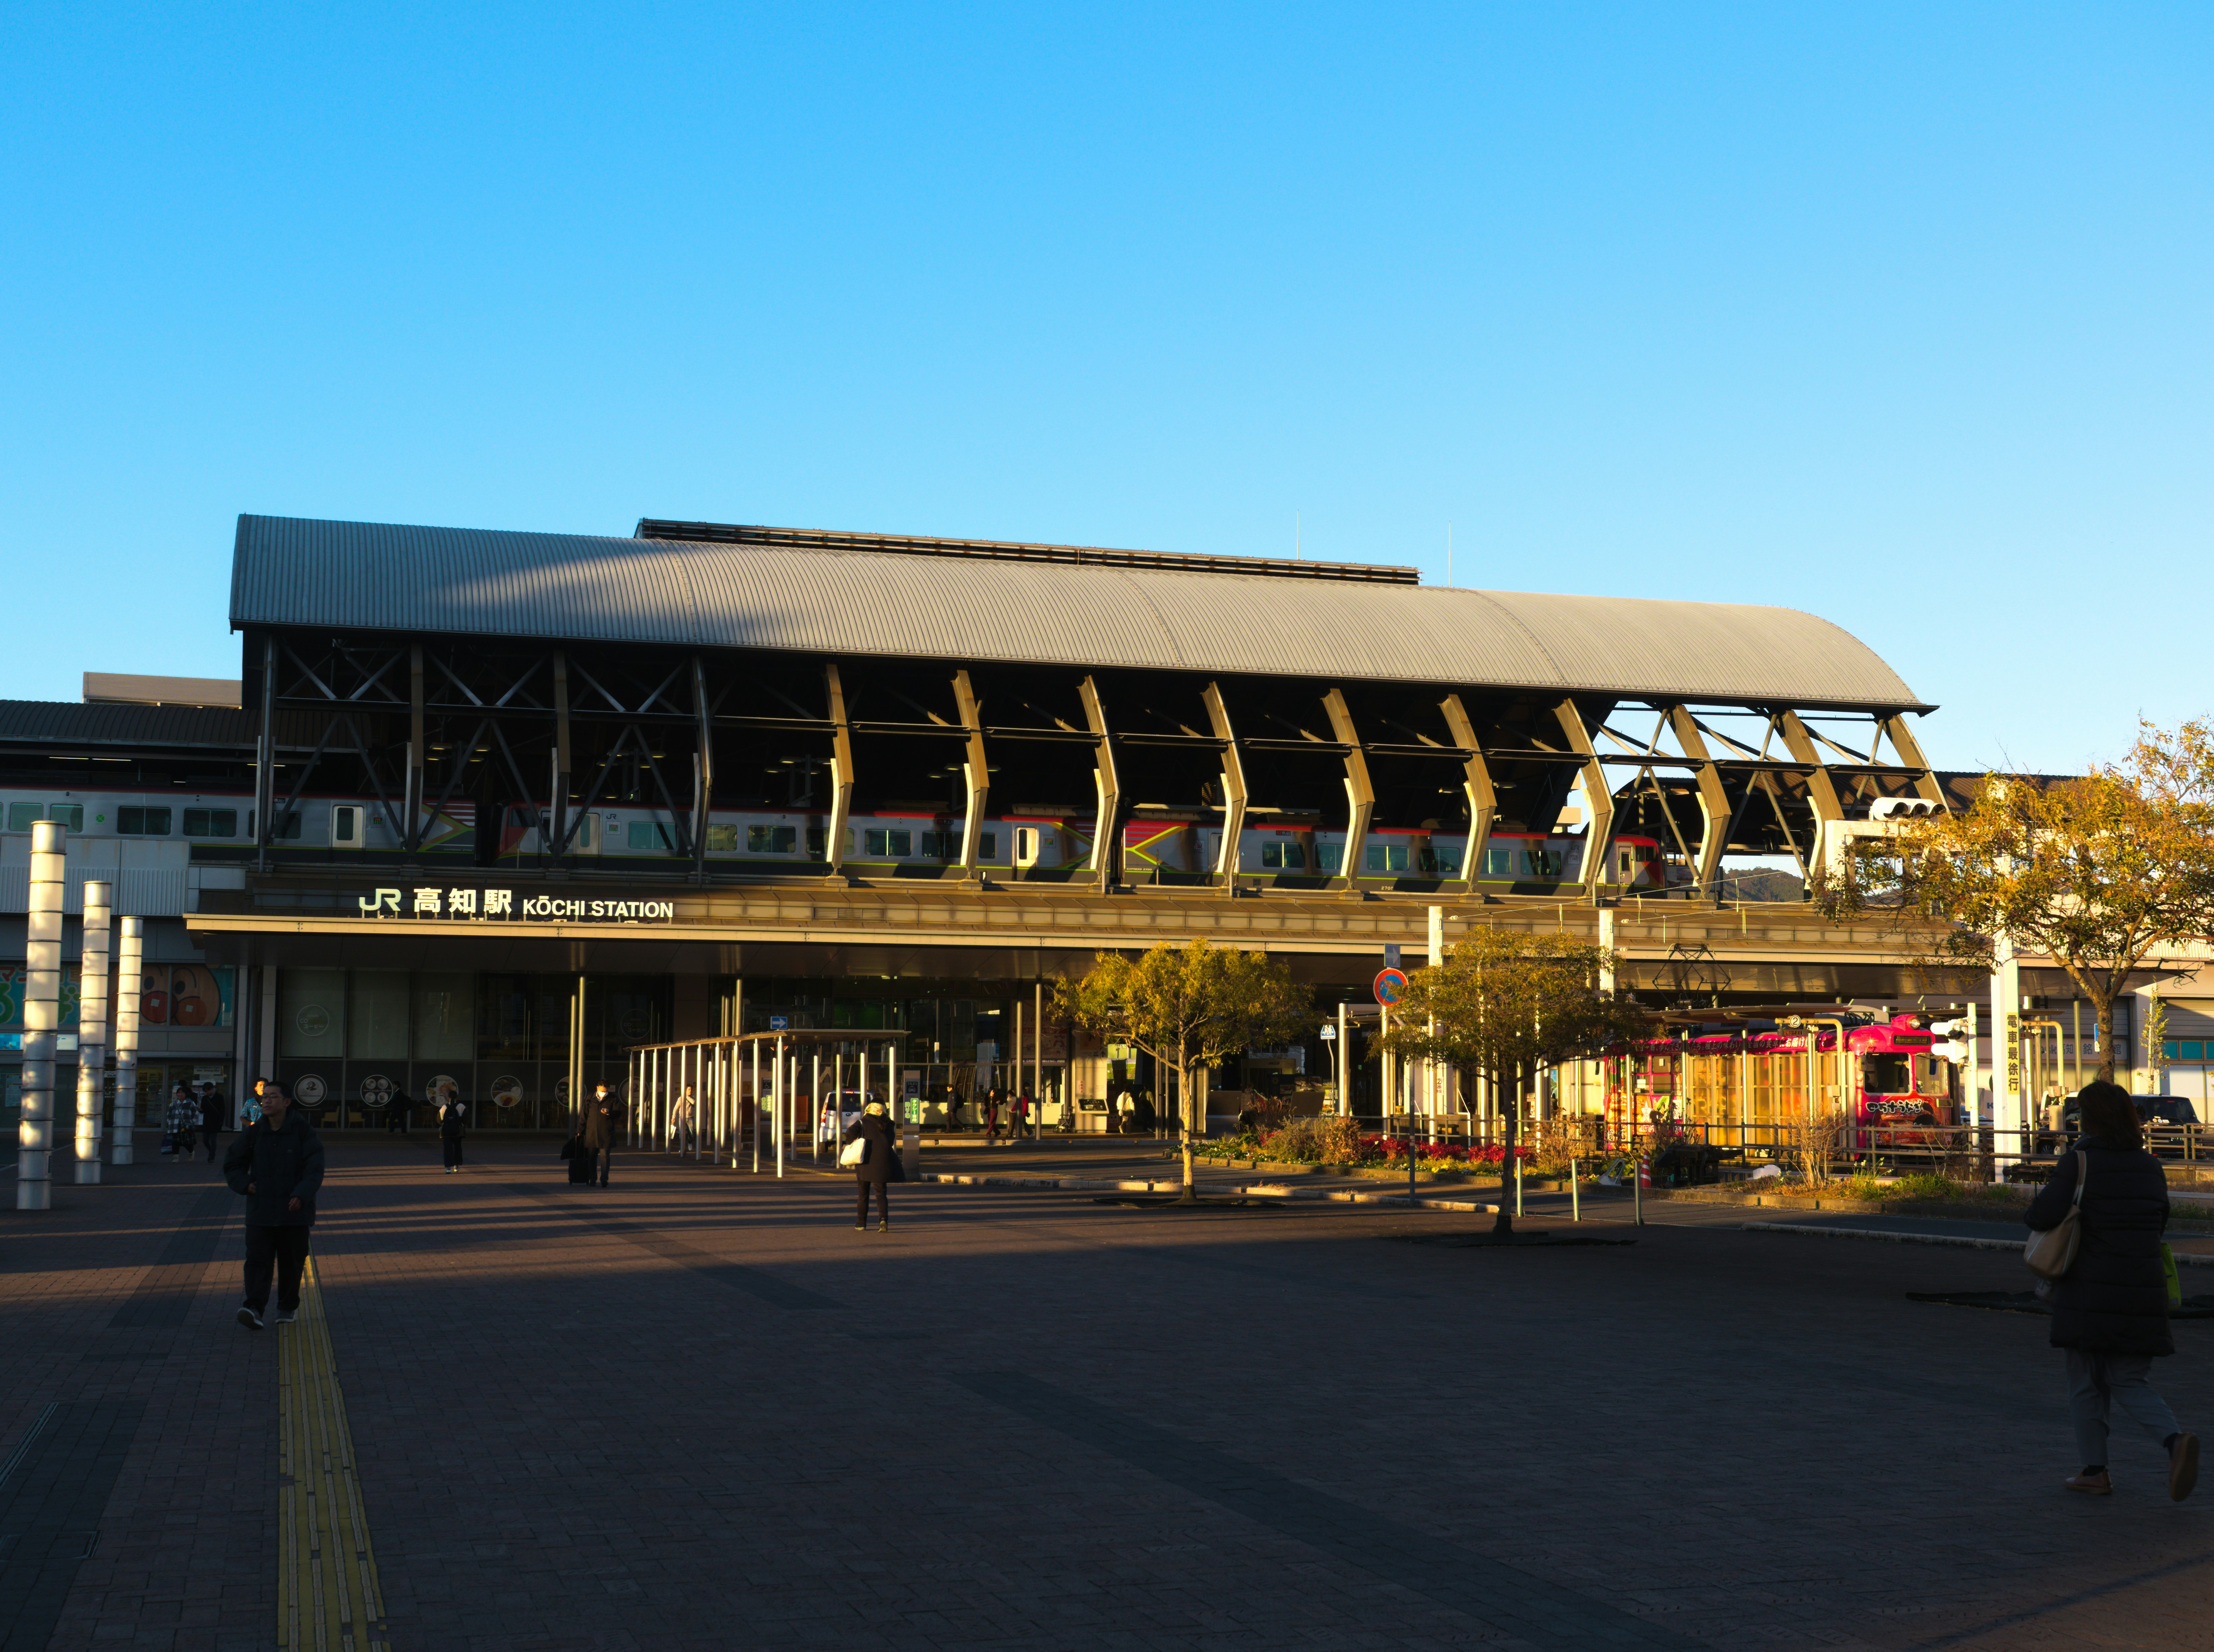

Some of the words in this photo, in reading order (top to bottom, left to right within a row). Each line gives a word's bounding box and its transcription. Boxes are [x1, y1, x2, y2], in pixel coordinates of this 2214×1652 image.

[359, 888, 402, 911] JR
[413, 887, 512, 914] 高知駅
[523, 895, 585, 916] KŌCHI
[591, 900, 673, 917] STATION
[2007, 1015, 2019, 1091] 電車最徐行
